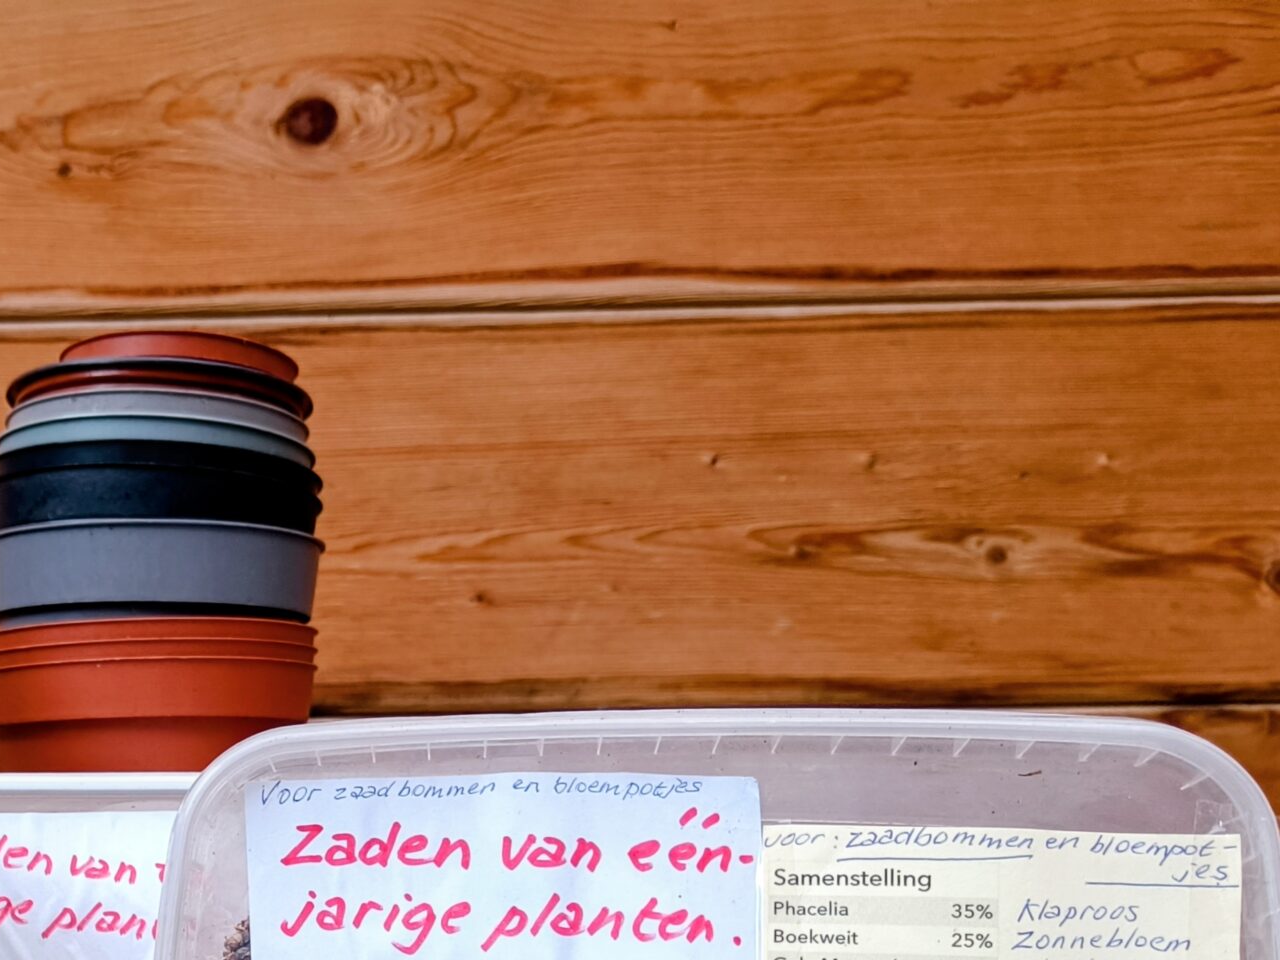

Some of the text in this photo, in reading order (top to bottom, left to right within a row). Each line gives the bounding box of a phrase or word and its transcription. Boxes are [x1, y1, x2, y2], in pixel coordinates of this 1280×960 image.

[261, 777, 702, 806] Voor zaadbommen en bloempotjes
[280, 821, 470, 870] Zaden
[502, 833, 602, 872] van
[846, 827, 1034, 851] zaadbommen
[1045, 835, 1080, 850] en
[70, 855, 137, 884] van
[774, 868, 932, 892] Samenstelling
[1171, 862, 1228, 883] jes
[41, 902, 158, 940] plan
[280, 890, 741, 955] jarige planten.
[773, 901, 994, 920] Phacelia 35%
[1017, 898, 1140, 927] Klaproos
[773, 928, 994, 949] Boekweit 25%
[1011, 927, 1191, 952] Zonnebloem
